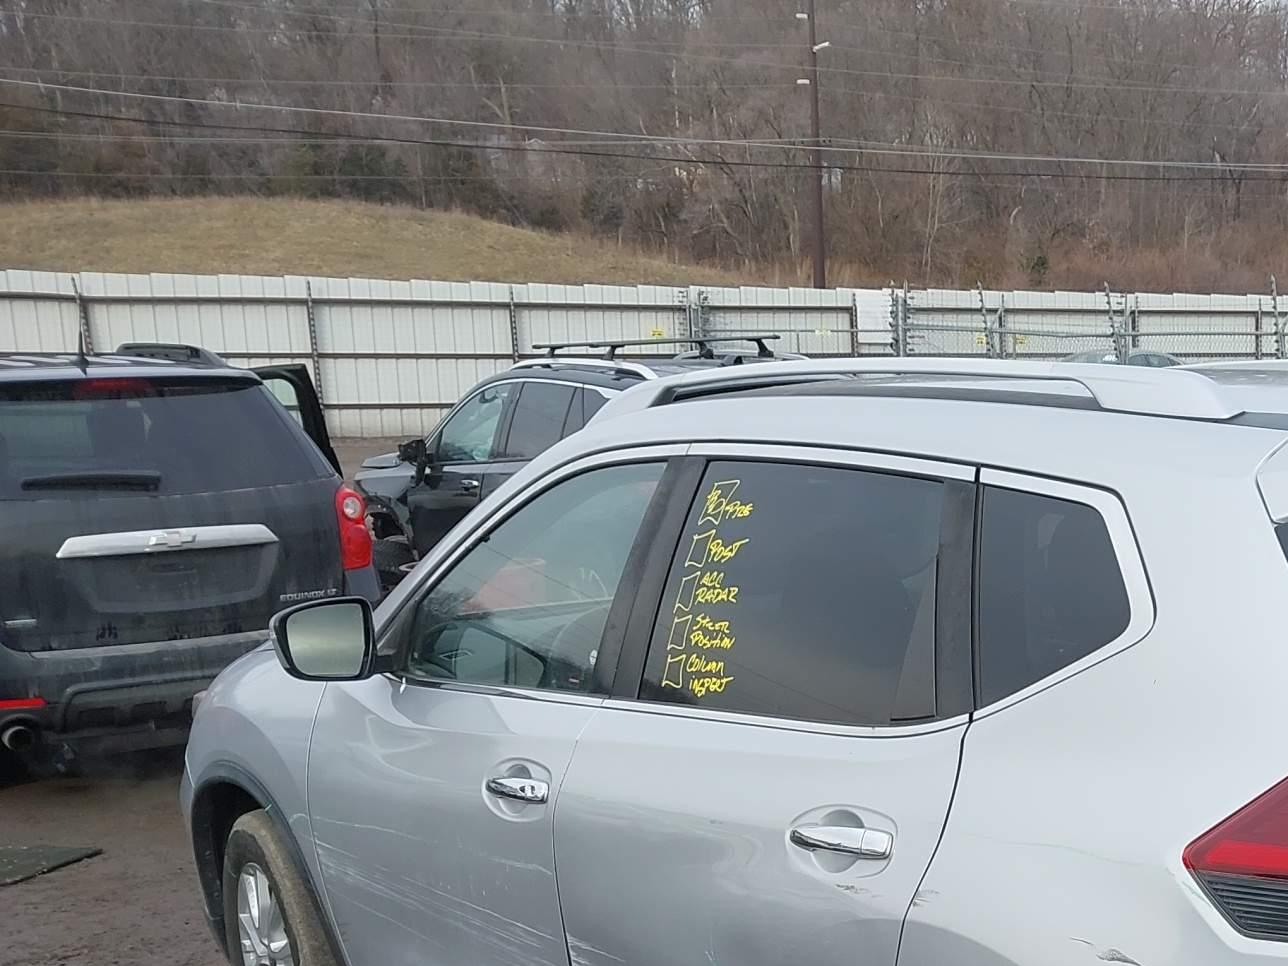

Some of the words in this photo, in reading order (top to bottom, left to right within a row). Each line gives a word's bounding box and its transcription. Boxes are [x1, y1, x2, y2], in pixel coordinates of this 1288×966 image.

[709, 539, 749, 562] POST
[280, 590, 325, 601] EQUINOX
[695, 587, 738, 605] RADAR
